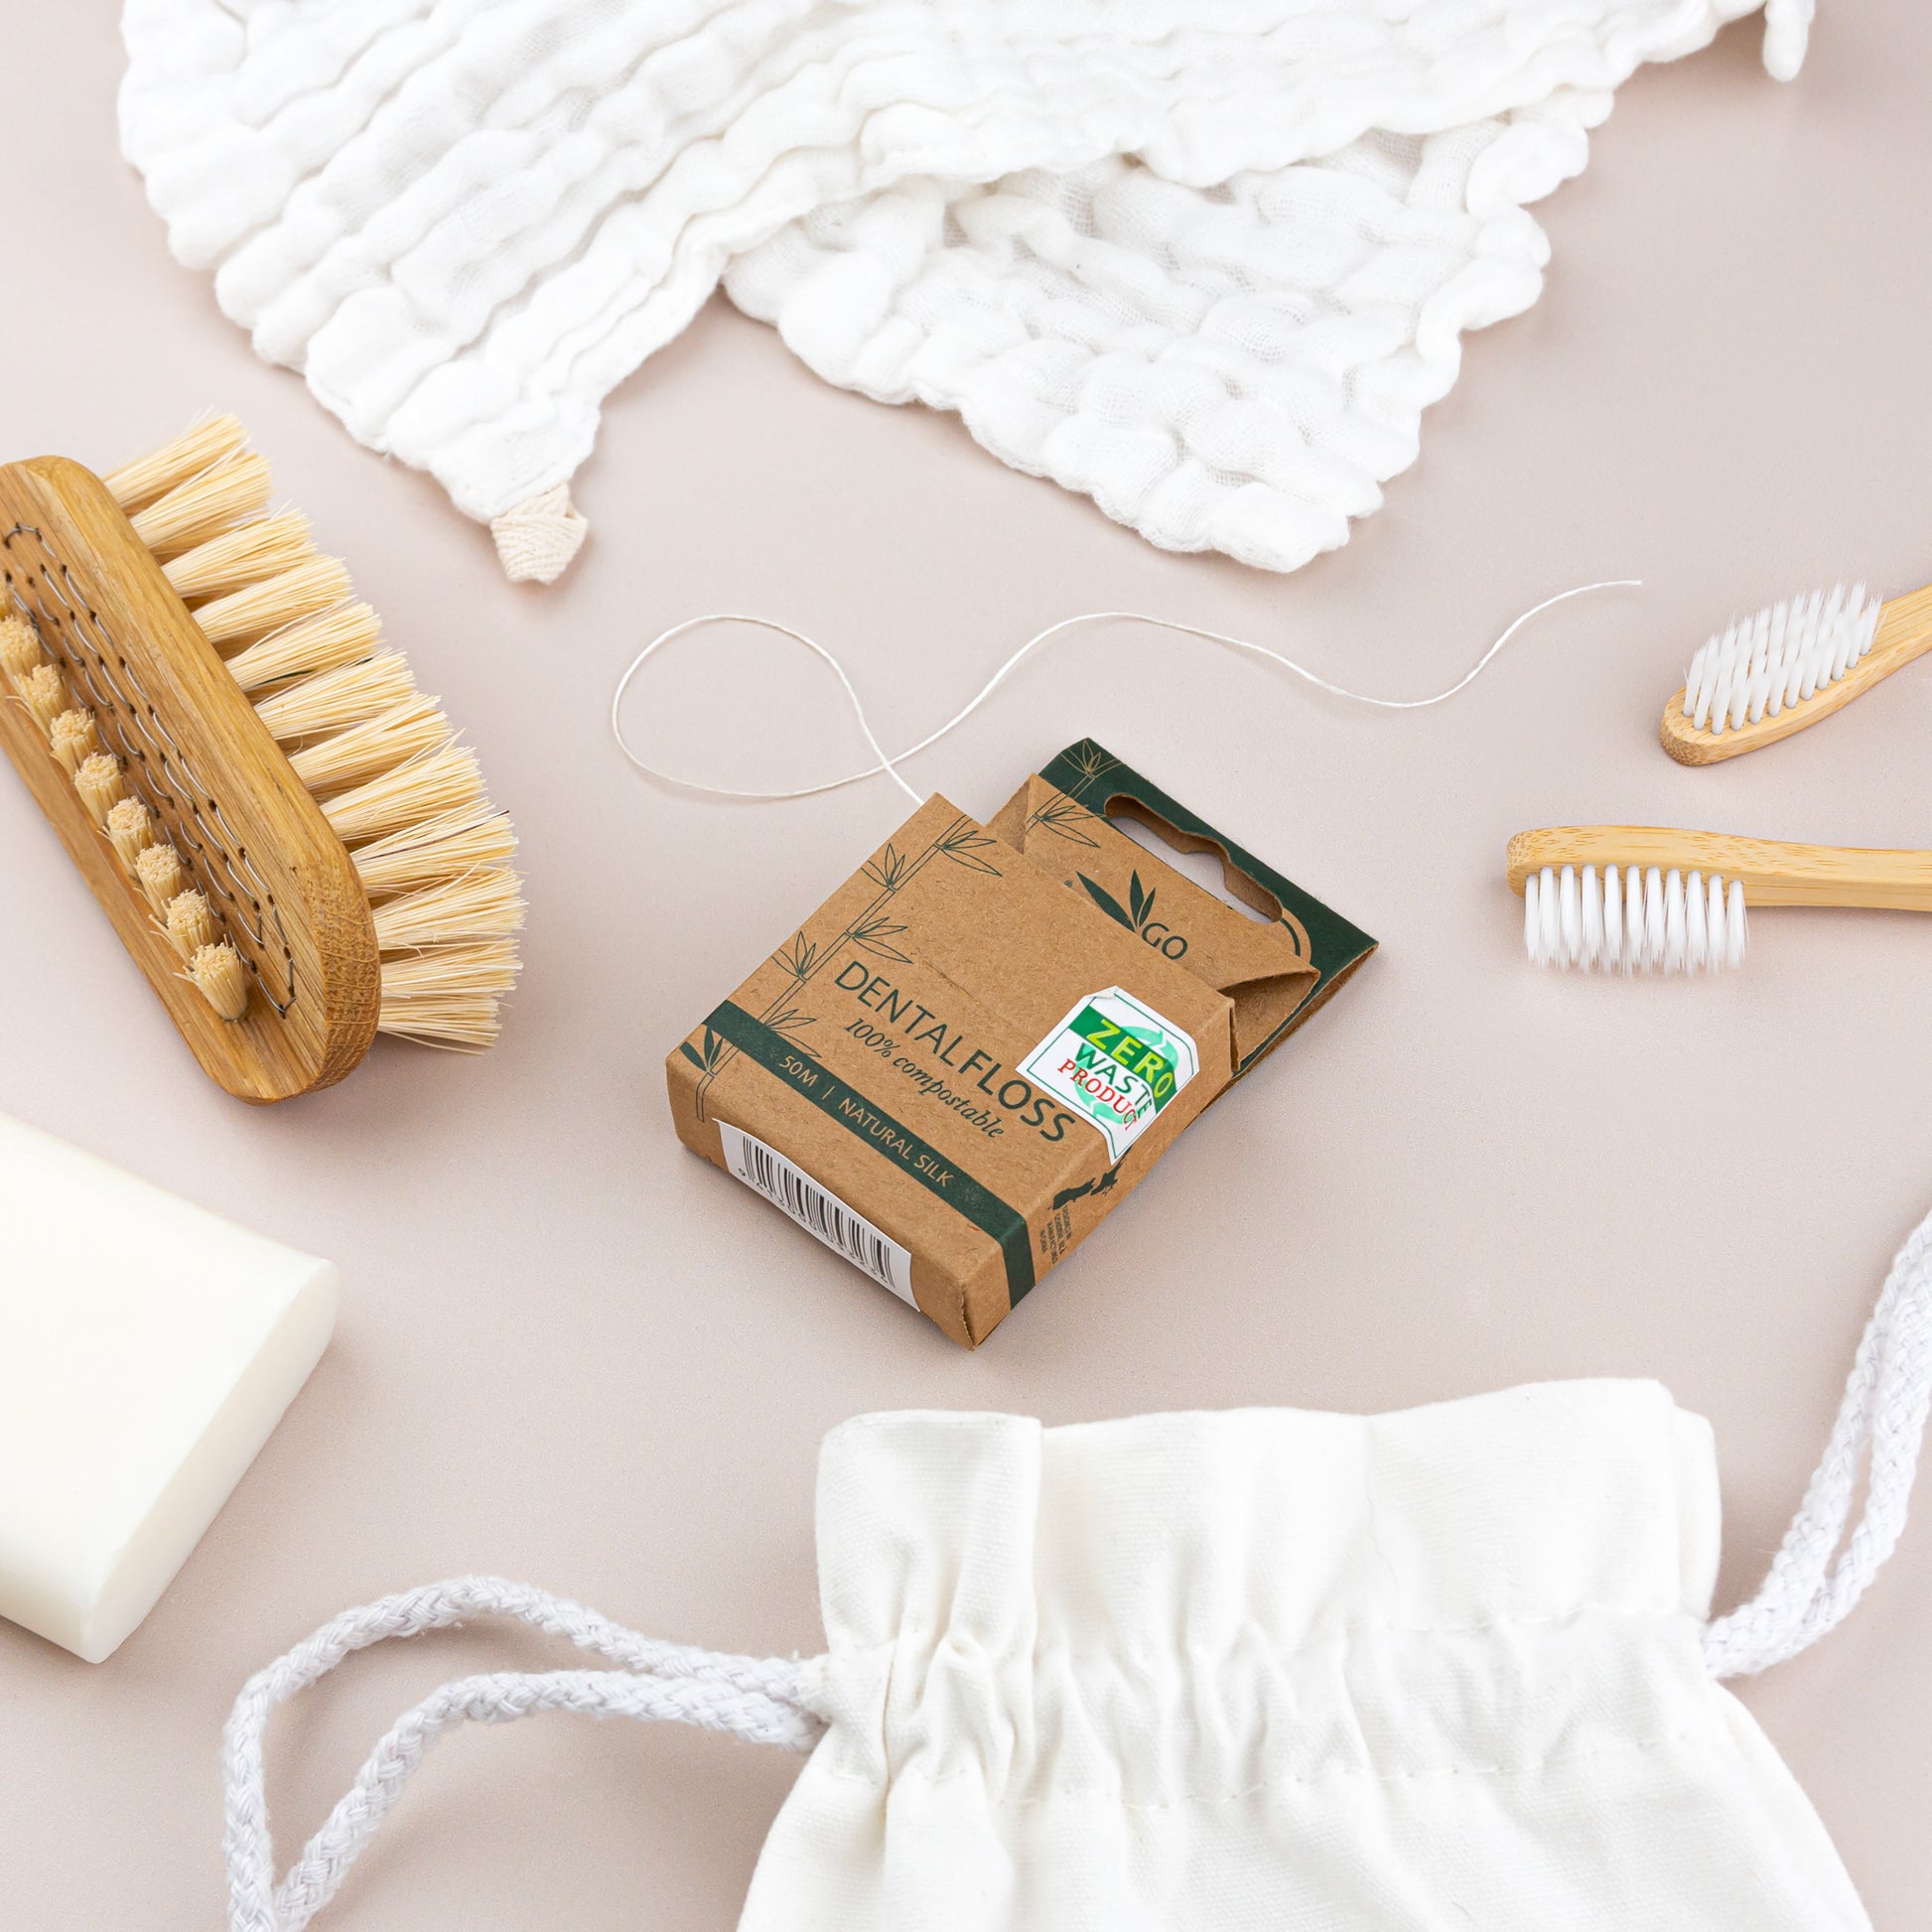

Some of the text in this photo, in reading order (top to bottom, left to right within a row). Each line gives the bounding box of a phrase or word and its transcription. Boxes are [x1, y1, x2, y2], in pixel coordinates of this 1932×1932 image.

[1141, 921, 1188, 961] GO
[843, 1017, 1005, 1139] 100% compostable
[1056, 1057, 1138, 1132] PRODUCT
[1074, 1042, 1153, 1119] WASTE
[1085, 1018, 1174, 1098] ZERO
[778, 1054, 819, 1088] 50M
[838, 1097, 914, 1161] NATURAL
[913, 1154, 954, 1187] SILK
